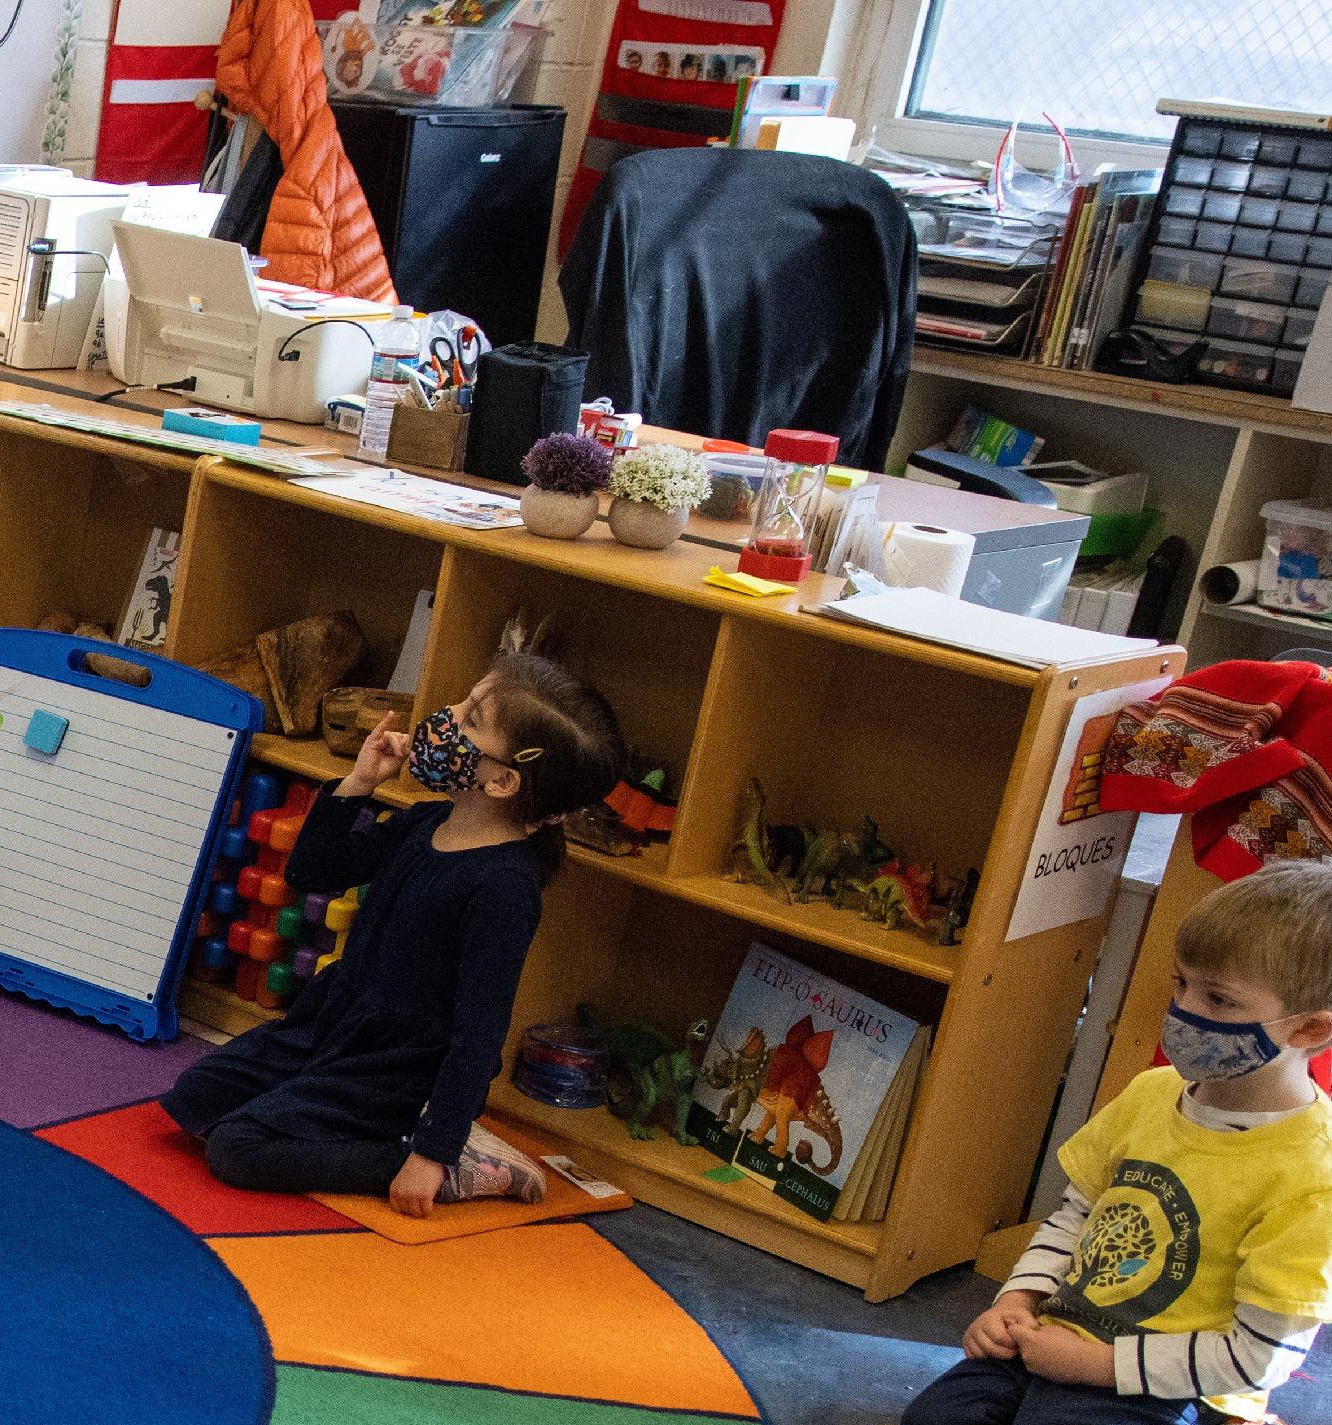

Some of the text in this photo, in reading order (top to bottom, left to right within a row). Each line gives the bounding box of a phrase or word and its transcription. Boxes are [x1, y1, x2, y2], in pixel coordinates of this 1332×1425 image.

[1035, 836, 1115, 879] BLOQUES
[749, 1156, 768, 1172] SAU
[785, 1178, 830, 1211] CEPHALUS
[1123, 1170, 1188, 1281] EDUCATE EMPOWER
